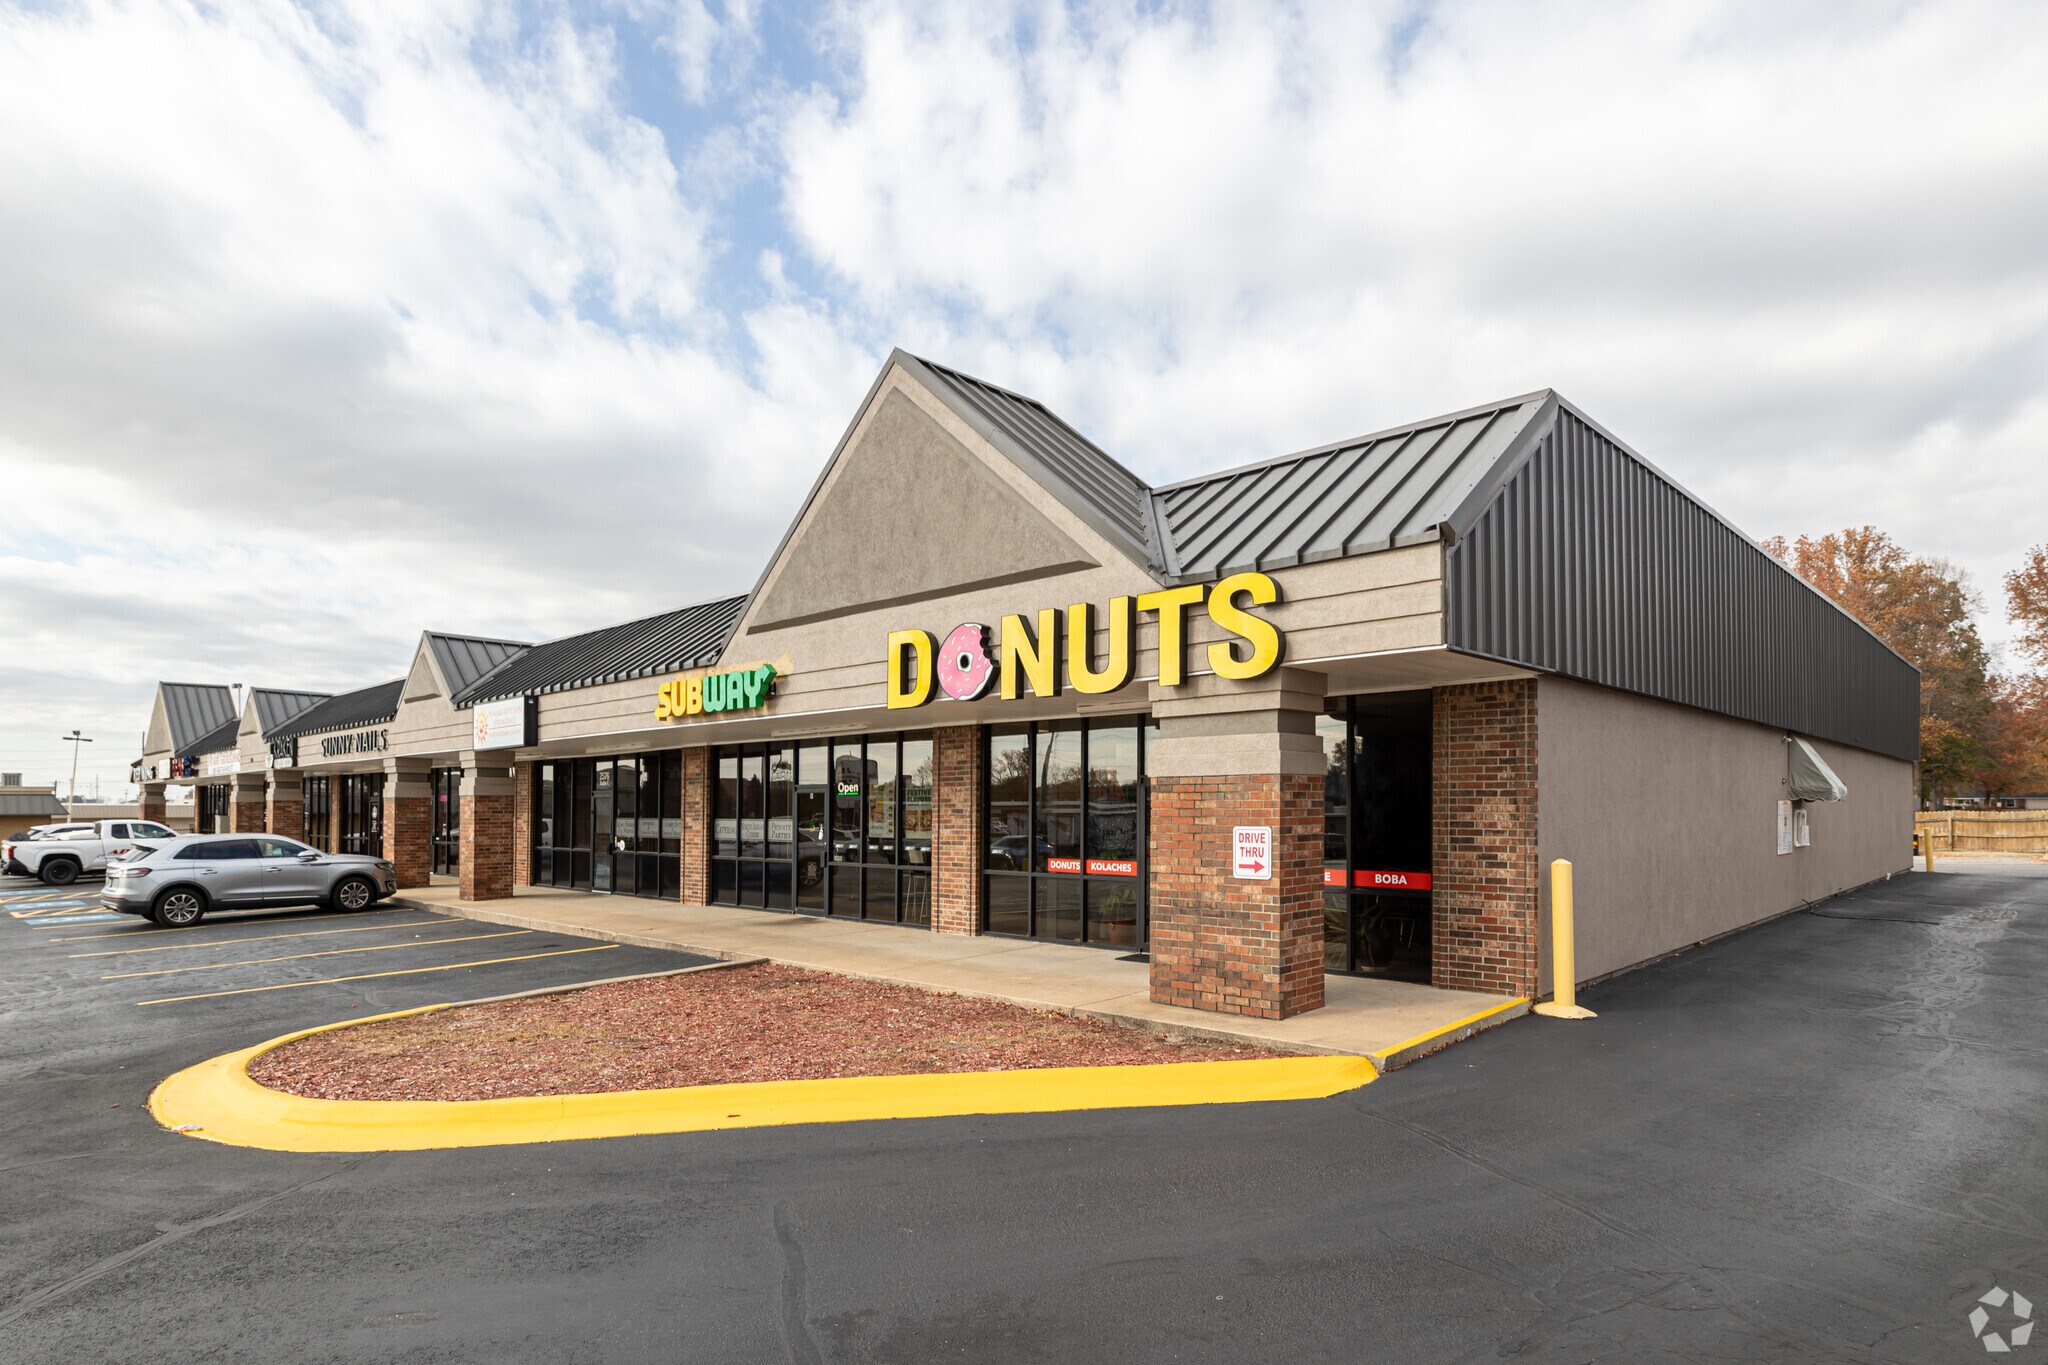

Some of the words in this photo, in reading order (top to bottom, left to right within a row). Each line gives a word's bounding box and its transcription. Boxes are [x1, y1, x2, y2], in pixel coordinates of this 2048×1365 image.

[887, 572, 1286, 710] DONUTS
[654, 664, 778, 721] SUBWAY
[321, 734, 353, 757] SUNNY
[355, 728, 390, 753] NAILS
[838, 782, 859, 795] Open
[1239, 833, 1265, 844] DRIVE
[1240, 847, 1265, 858] THRU
[1050, 860, 1080, 870] DONUTS
[1091, 862, 1132, 873] KOLACHES
[1374, 873, 1408, 885] BOBA
